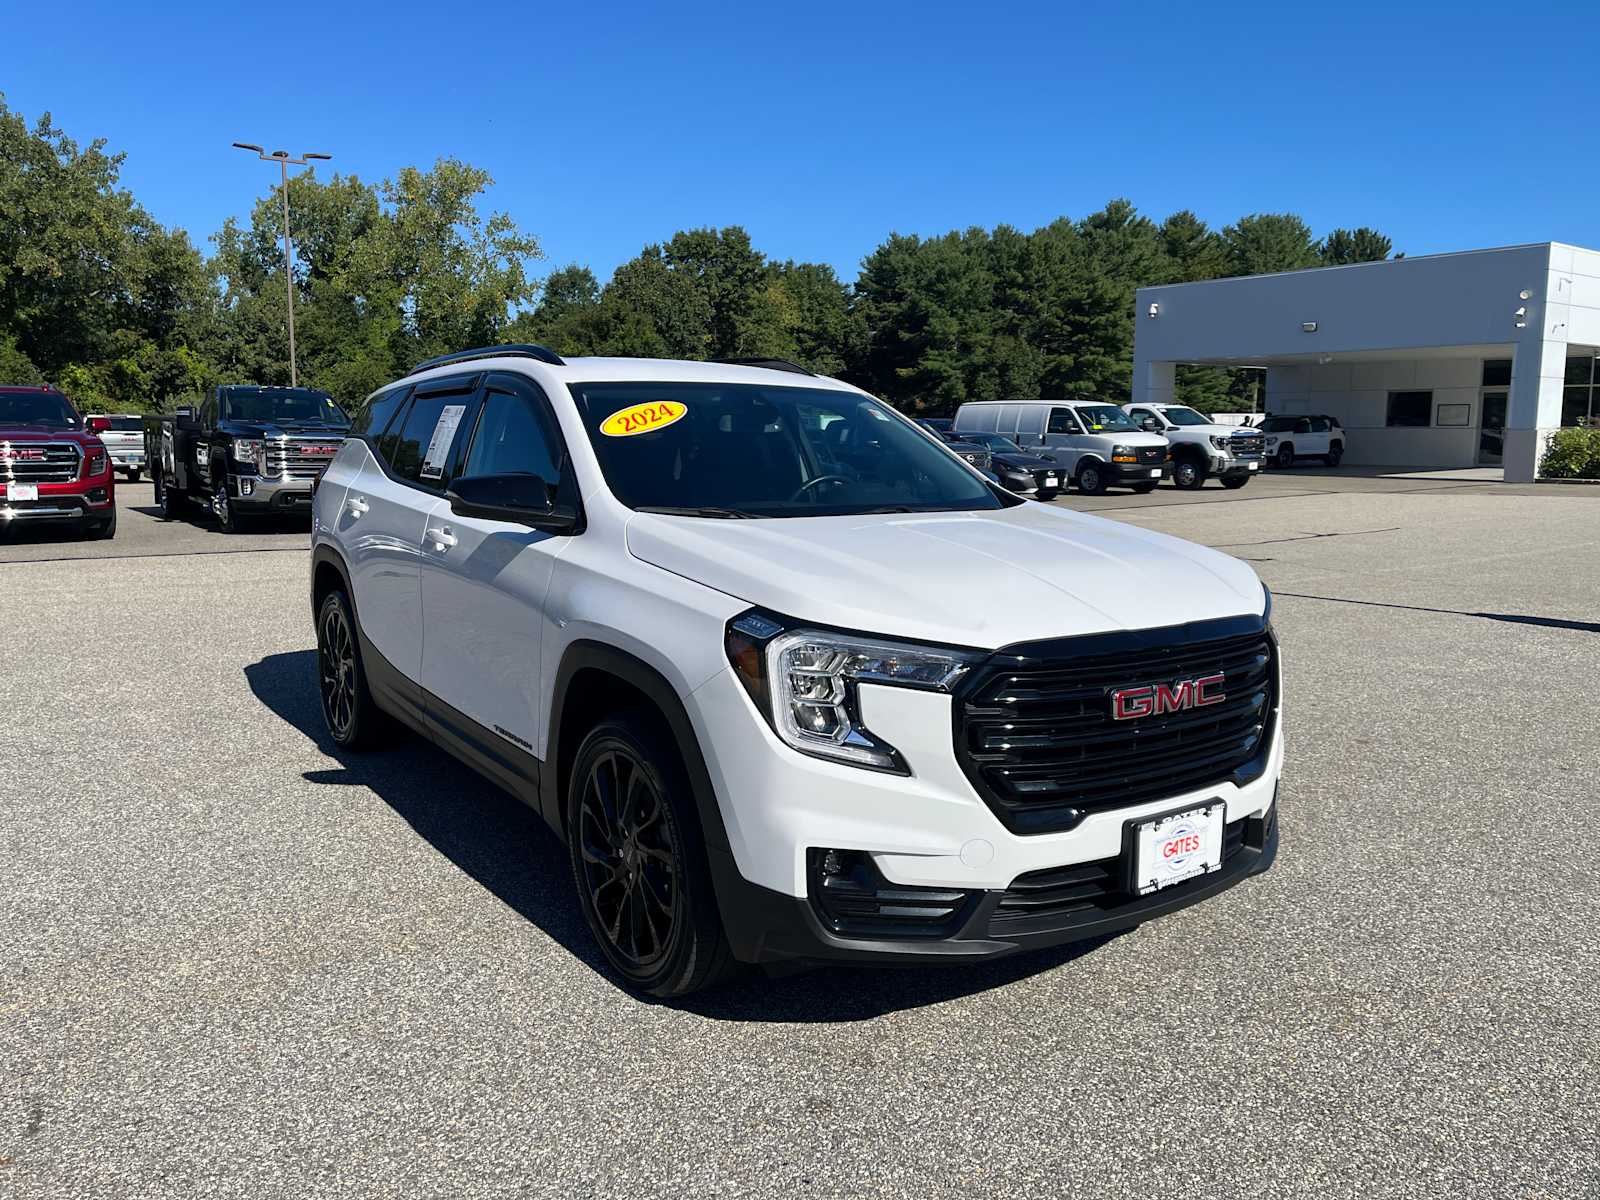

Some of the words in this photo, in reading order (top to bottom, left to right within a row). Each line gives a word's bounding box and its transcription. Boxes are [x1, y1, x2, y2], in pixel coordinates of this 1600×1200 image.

[617, 404, 674, 432] 2024
[1111, 674, 1226, 720] GMC
[1163, 835, 1200, 858] GATES
